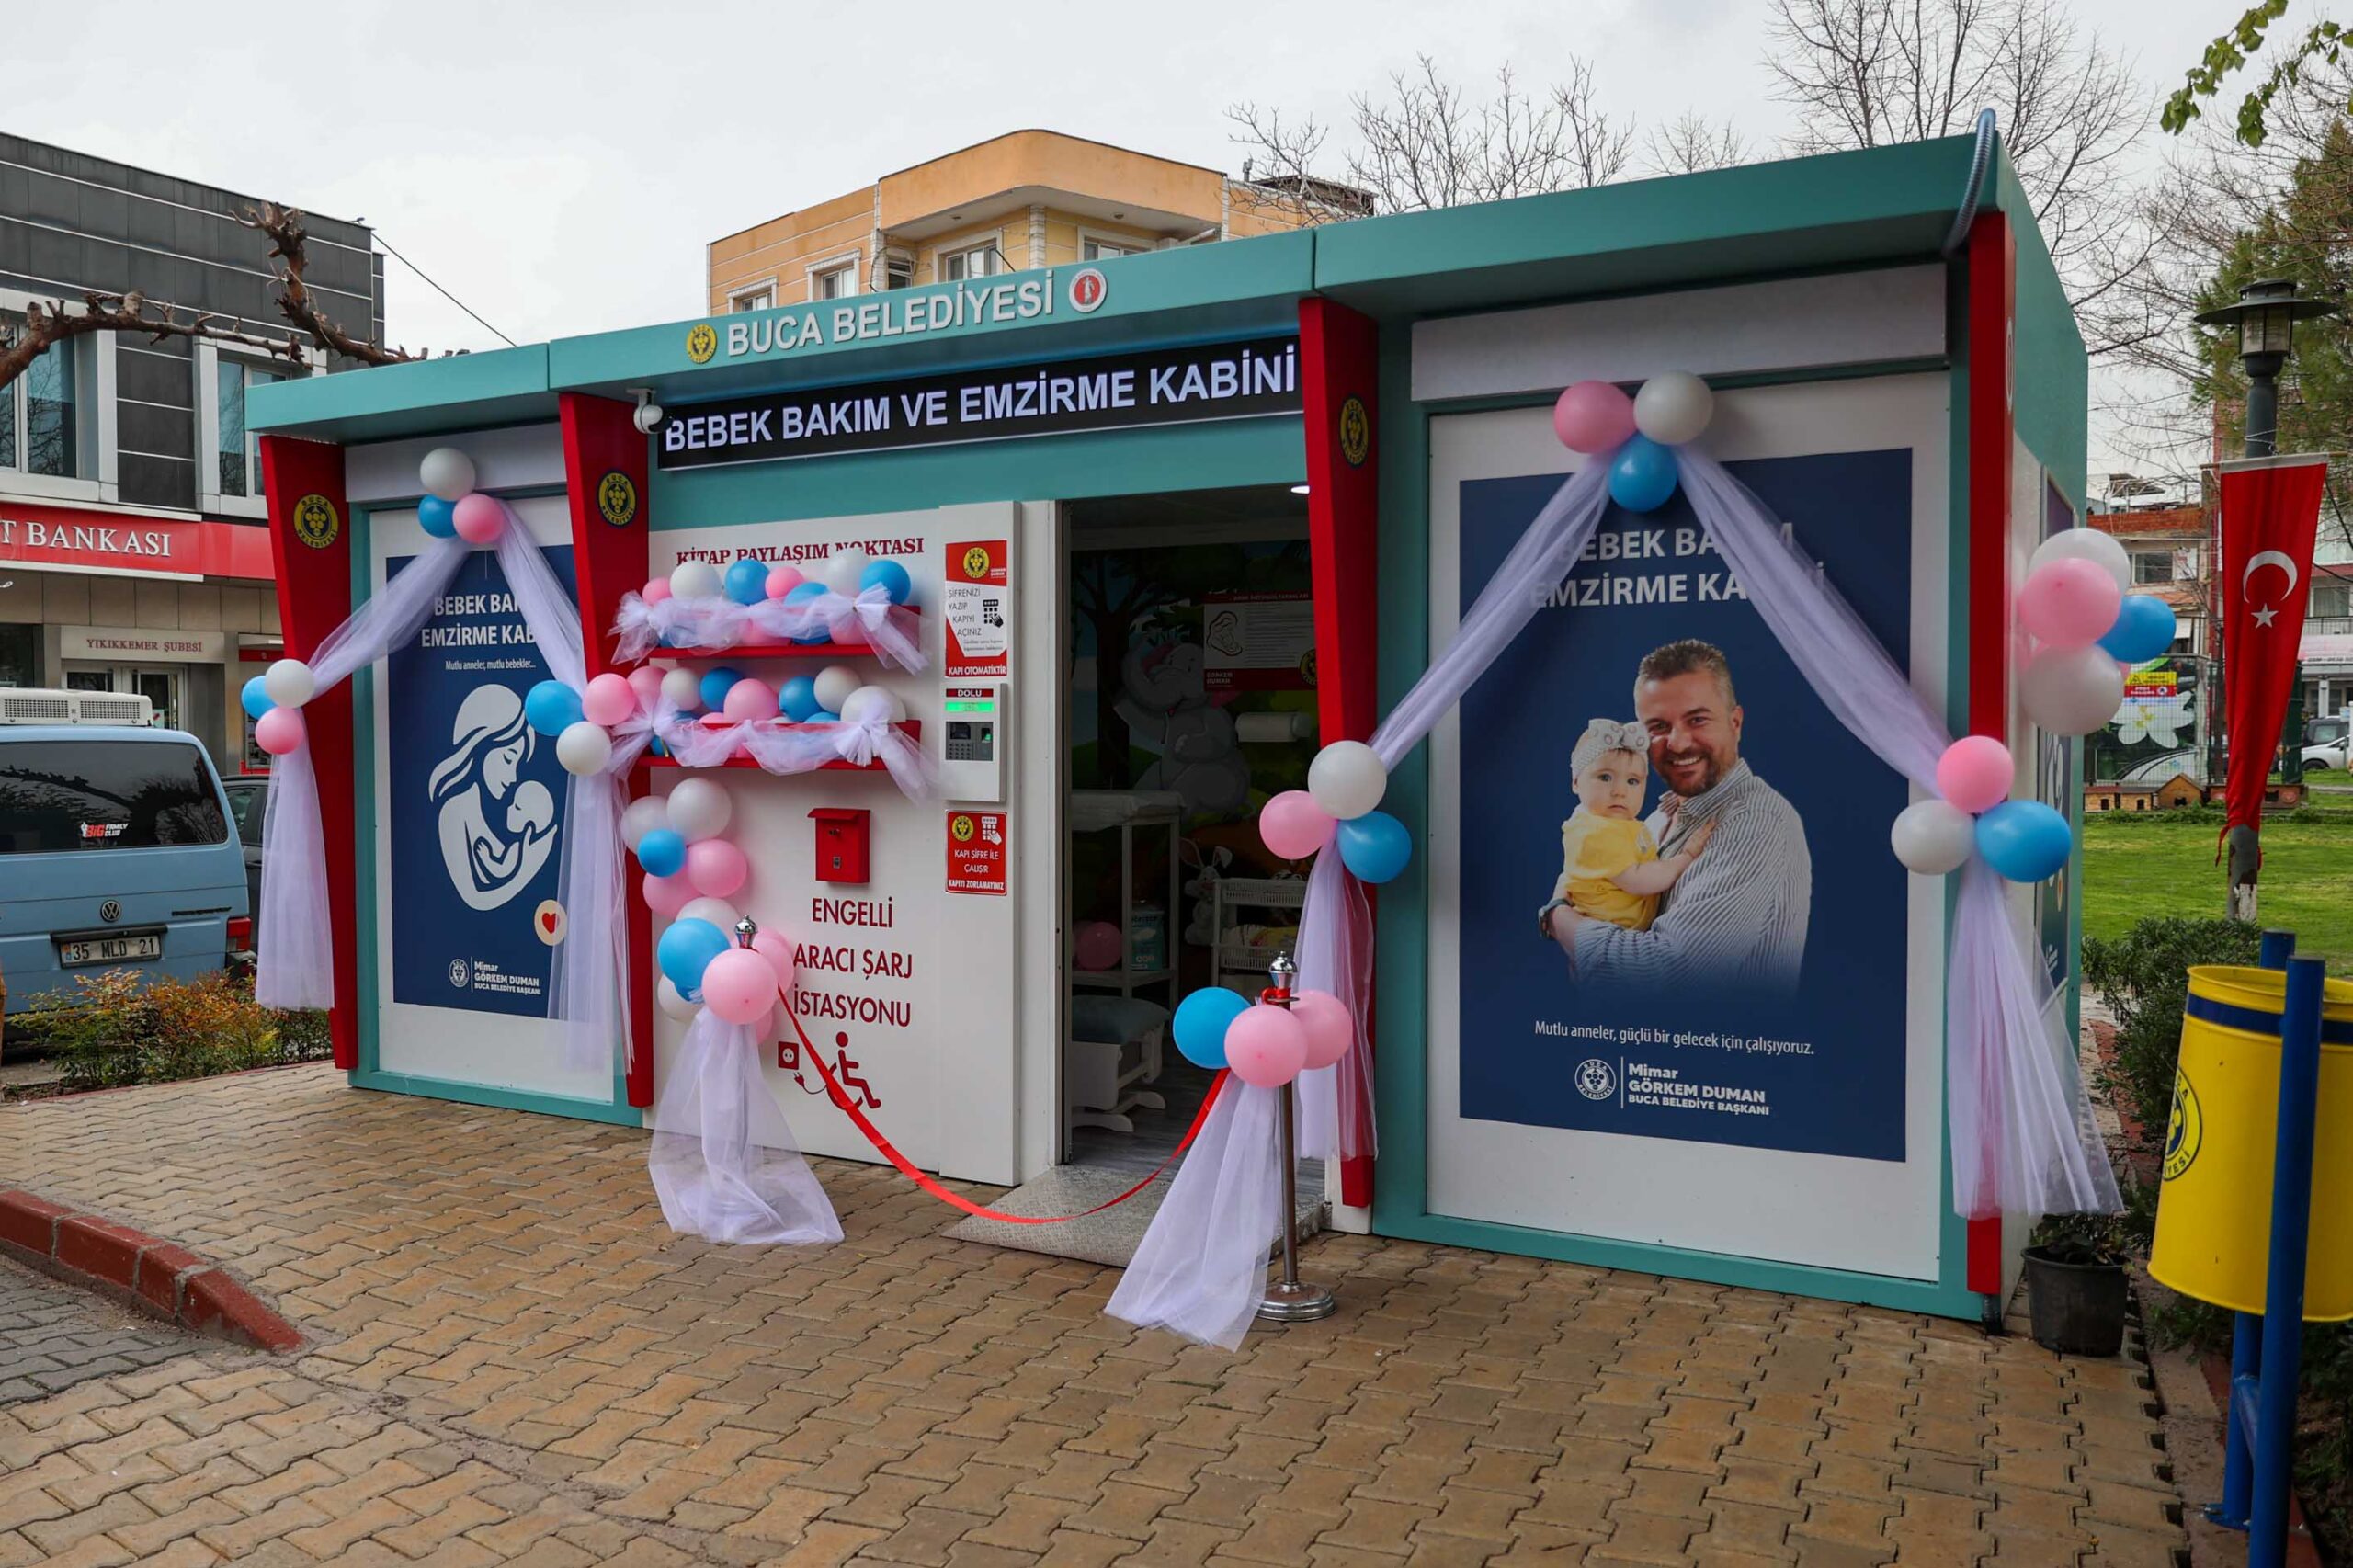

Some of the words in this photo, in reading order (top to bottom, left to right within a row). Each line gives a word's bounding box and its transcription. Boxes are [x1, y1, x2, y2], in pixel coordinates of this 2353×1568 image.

[727, 313, 824, 357] BUCA
[832, 270, 1054, 343] BELEDİYESİ
[665, 409, 773, 451] BEBEK
[782, 396, 890, 439] BAKIM
[901, 390, 948, 427] VE
[960, 370, 1136, 422] EMZİRME
[1149, 345, 1296, 404] KABİNİ
[26, 521, 172, 557] BANKASI
[1579, 528, 1665, 562] EBEK
[676, 546, 731, 566] KİTAP
[736, 543, 830, 565] PAYLAŞIM
[435, 594, 487, 617] BEBEK
[422, 622, 497, 647] EMZİRME
[957, 628, 982, 637] AÇINIZ
[164, 641, 203, 653] ŞUBESİ
[949, 666, 963, 676] KAPI
[957, 689, 983, 698] DOLU
[954, 849, 970, 858] KAPI
[989, 849, 999, 860] İLE
[964, 864, 989, 874] ÇALIŞIR
[812, 896, 893, 928] ENGELLİ
[73, 943, 89, 960] 35
[101, 938, 128, 958] MLD
[139, 937, 155, 955] 21
[474, 960, 499, 971] Mimar
[793, 943, 855, 973] ARACI
[862, 949, 914, 981] ŞARJ
[474, 971, 508, 983] GÖRKEM
[509, 975, 540, 987] DUMAN
[793, 983, 912, 1028] İSTASYONU
[1535, 1020, 1568, 1037] Mutlu
[1570, 1025, 1617, 1042] anneler,
[1620, 1028, 1652, 1045] güçlü
[1654, 1028, 1671, 1044] bir
[1673, 1031, 1719, 1048] gelecek
[1721, 1034, 1743, 1051] için
[1745, 1036, 1815, 1056] çalışıyoruz.
[1628, 1062, 1679, 1080] Mimar
[1628, 1077, 1699, 1097] GÖRKEM
[1702, 1085, 1766, 1104] DUMAN
[1628, 1094, 1660, 1106] BUCA
[1662, 1097, 1715, 1111] BELEDİYE
[1717, 1101, 1770, 1116] BAŞKANI
